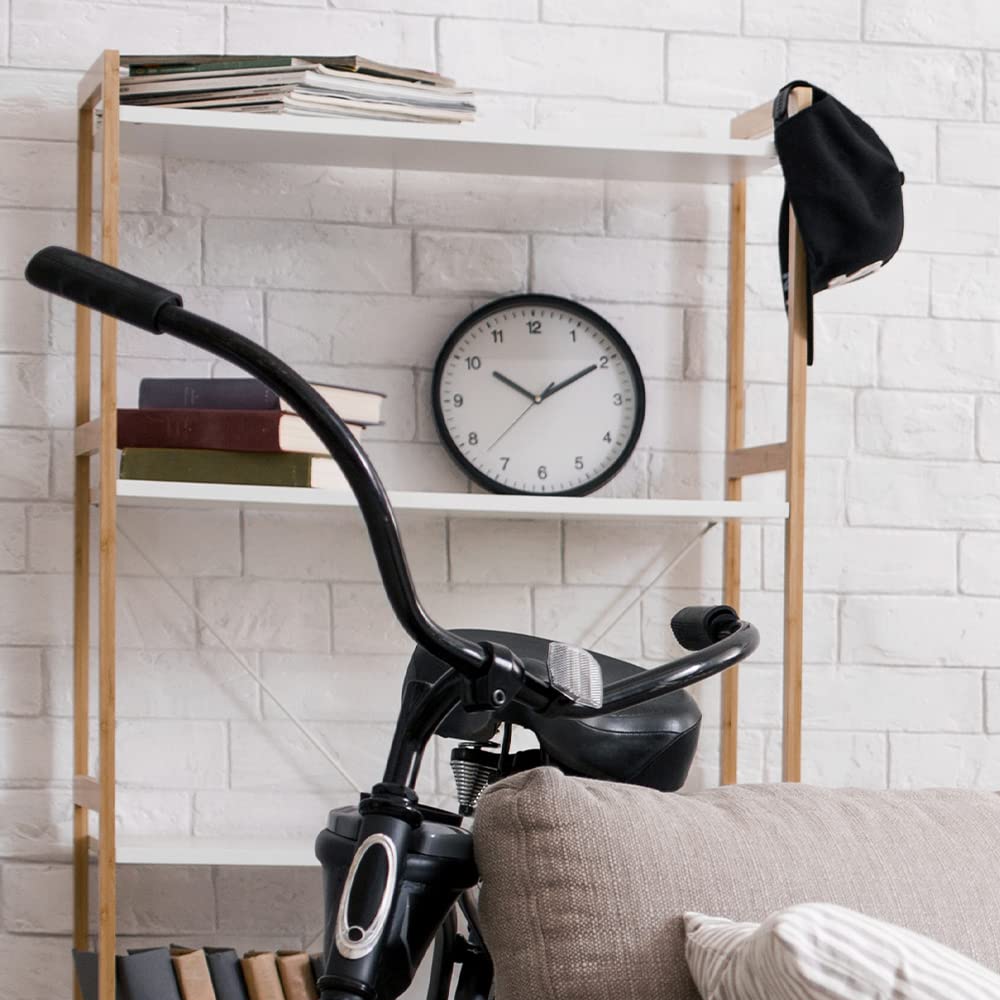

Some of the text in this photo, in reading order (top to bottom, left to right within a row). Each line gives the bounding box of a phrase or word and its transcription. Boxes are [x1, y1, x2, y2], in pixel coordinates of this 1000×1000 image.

[525, 320, 542, 335] 12
[490, 329, 504, 344] 11
[569, 329, 577, 343] 1
[464, 355, 482, 370] 10
[599, 355, 609, 369] 2
[453, 393, 464, 408] 9
[612, 392, 624, 407] 3
[467, 431, 479, 446] 8
[602, 431, 613, 444] 4
[499, 456, 511, 471] 7
[573, 456, 585, 470] 5
[537, 465, 548, 480] 6
